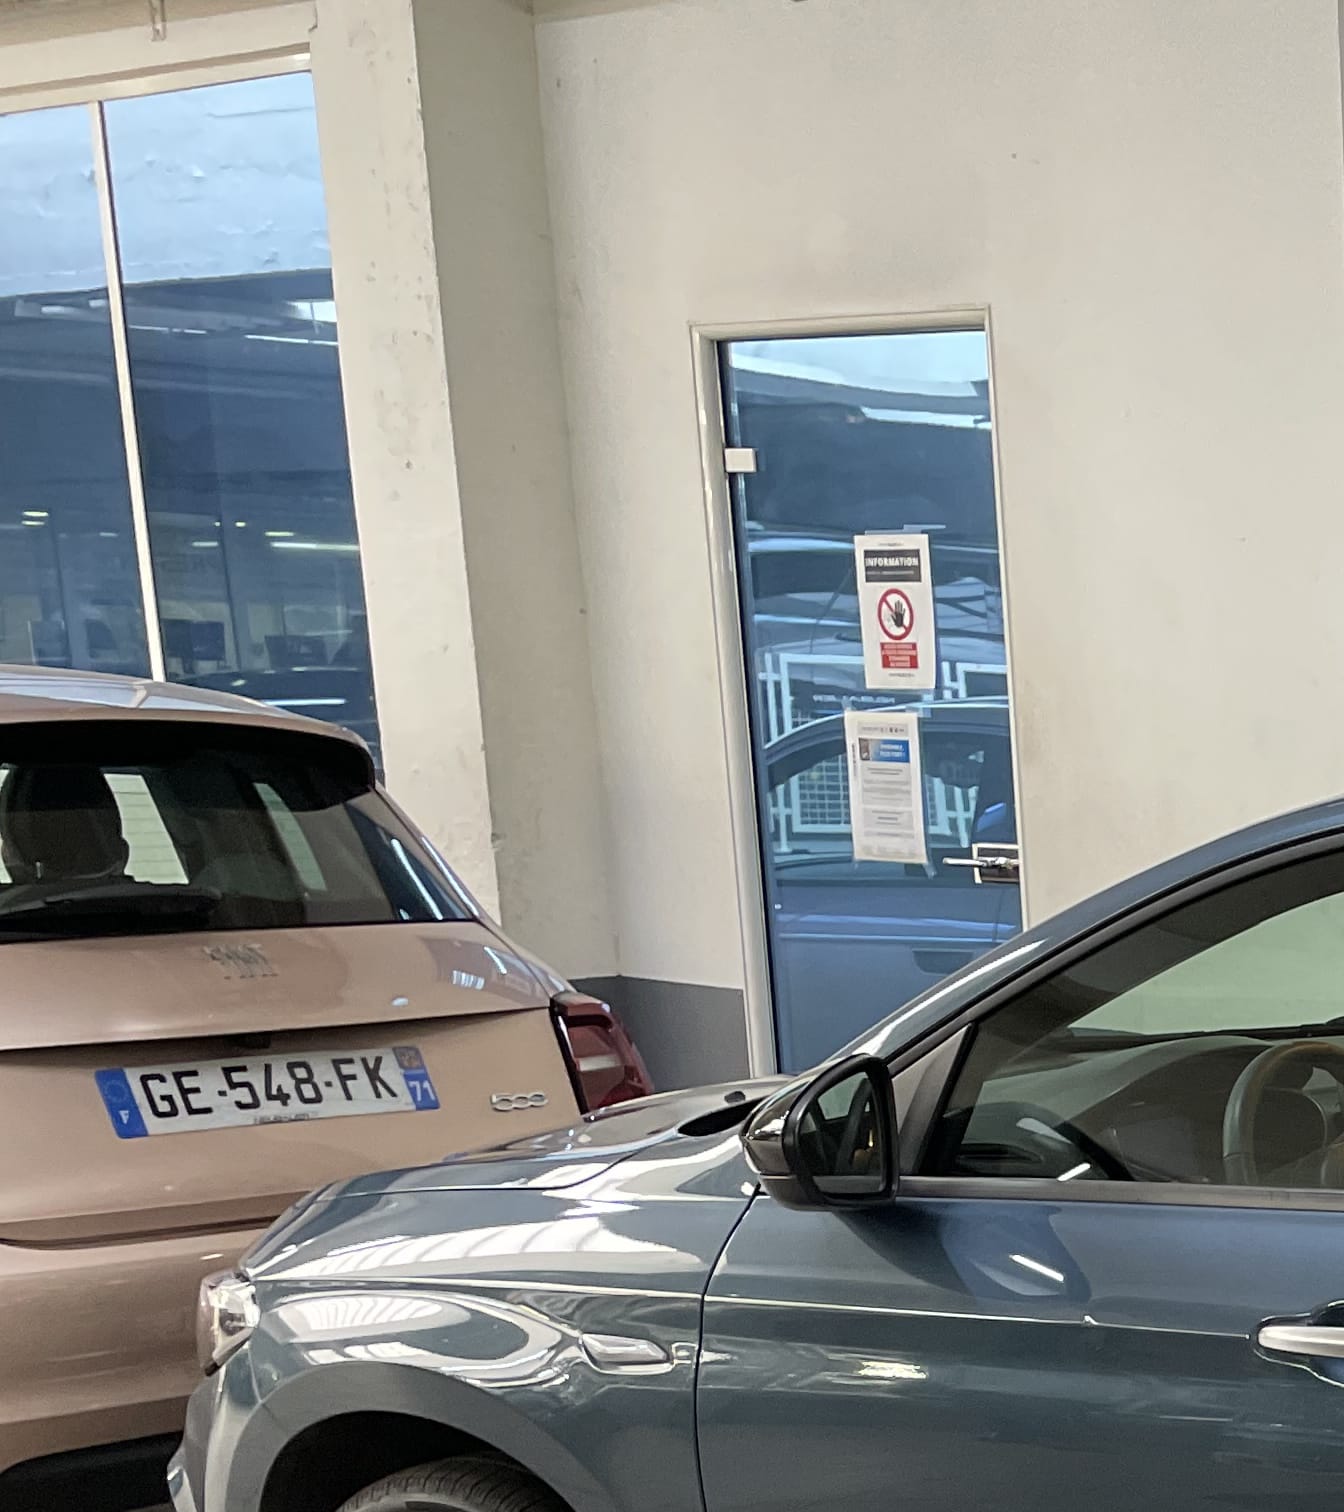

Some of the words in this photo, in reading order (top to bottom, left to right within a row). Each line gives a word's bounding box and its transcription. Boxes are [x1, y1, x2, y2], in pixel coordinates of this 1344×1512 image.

[864, 556, 919, 567] INFORMATION
[139, 1055, 399, 1119] GE-548-FK
[409, 1079, 437, 1103] 71
[490, 1091, 550, 1112] 500
[119, 1109, 130, 1125] F
